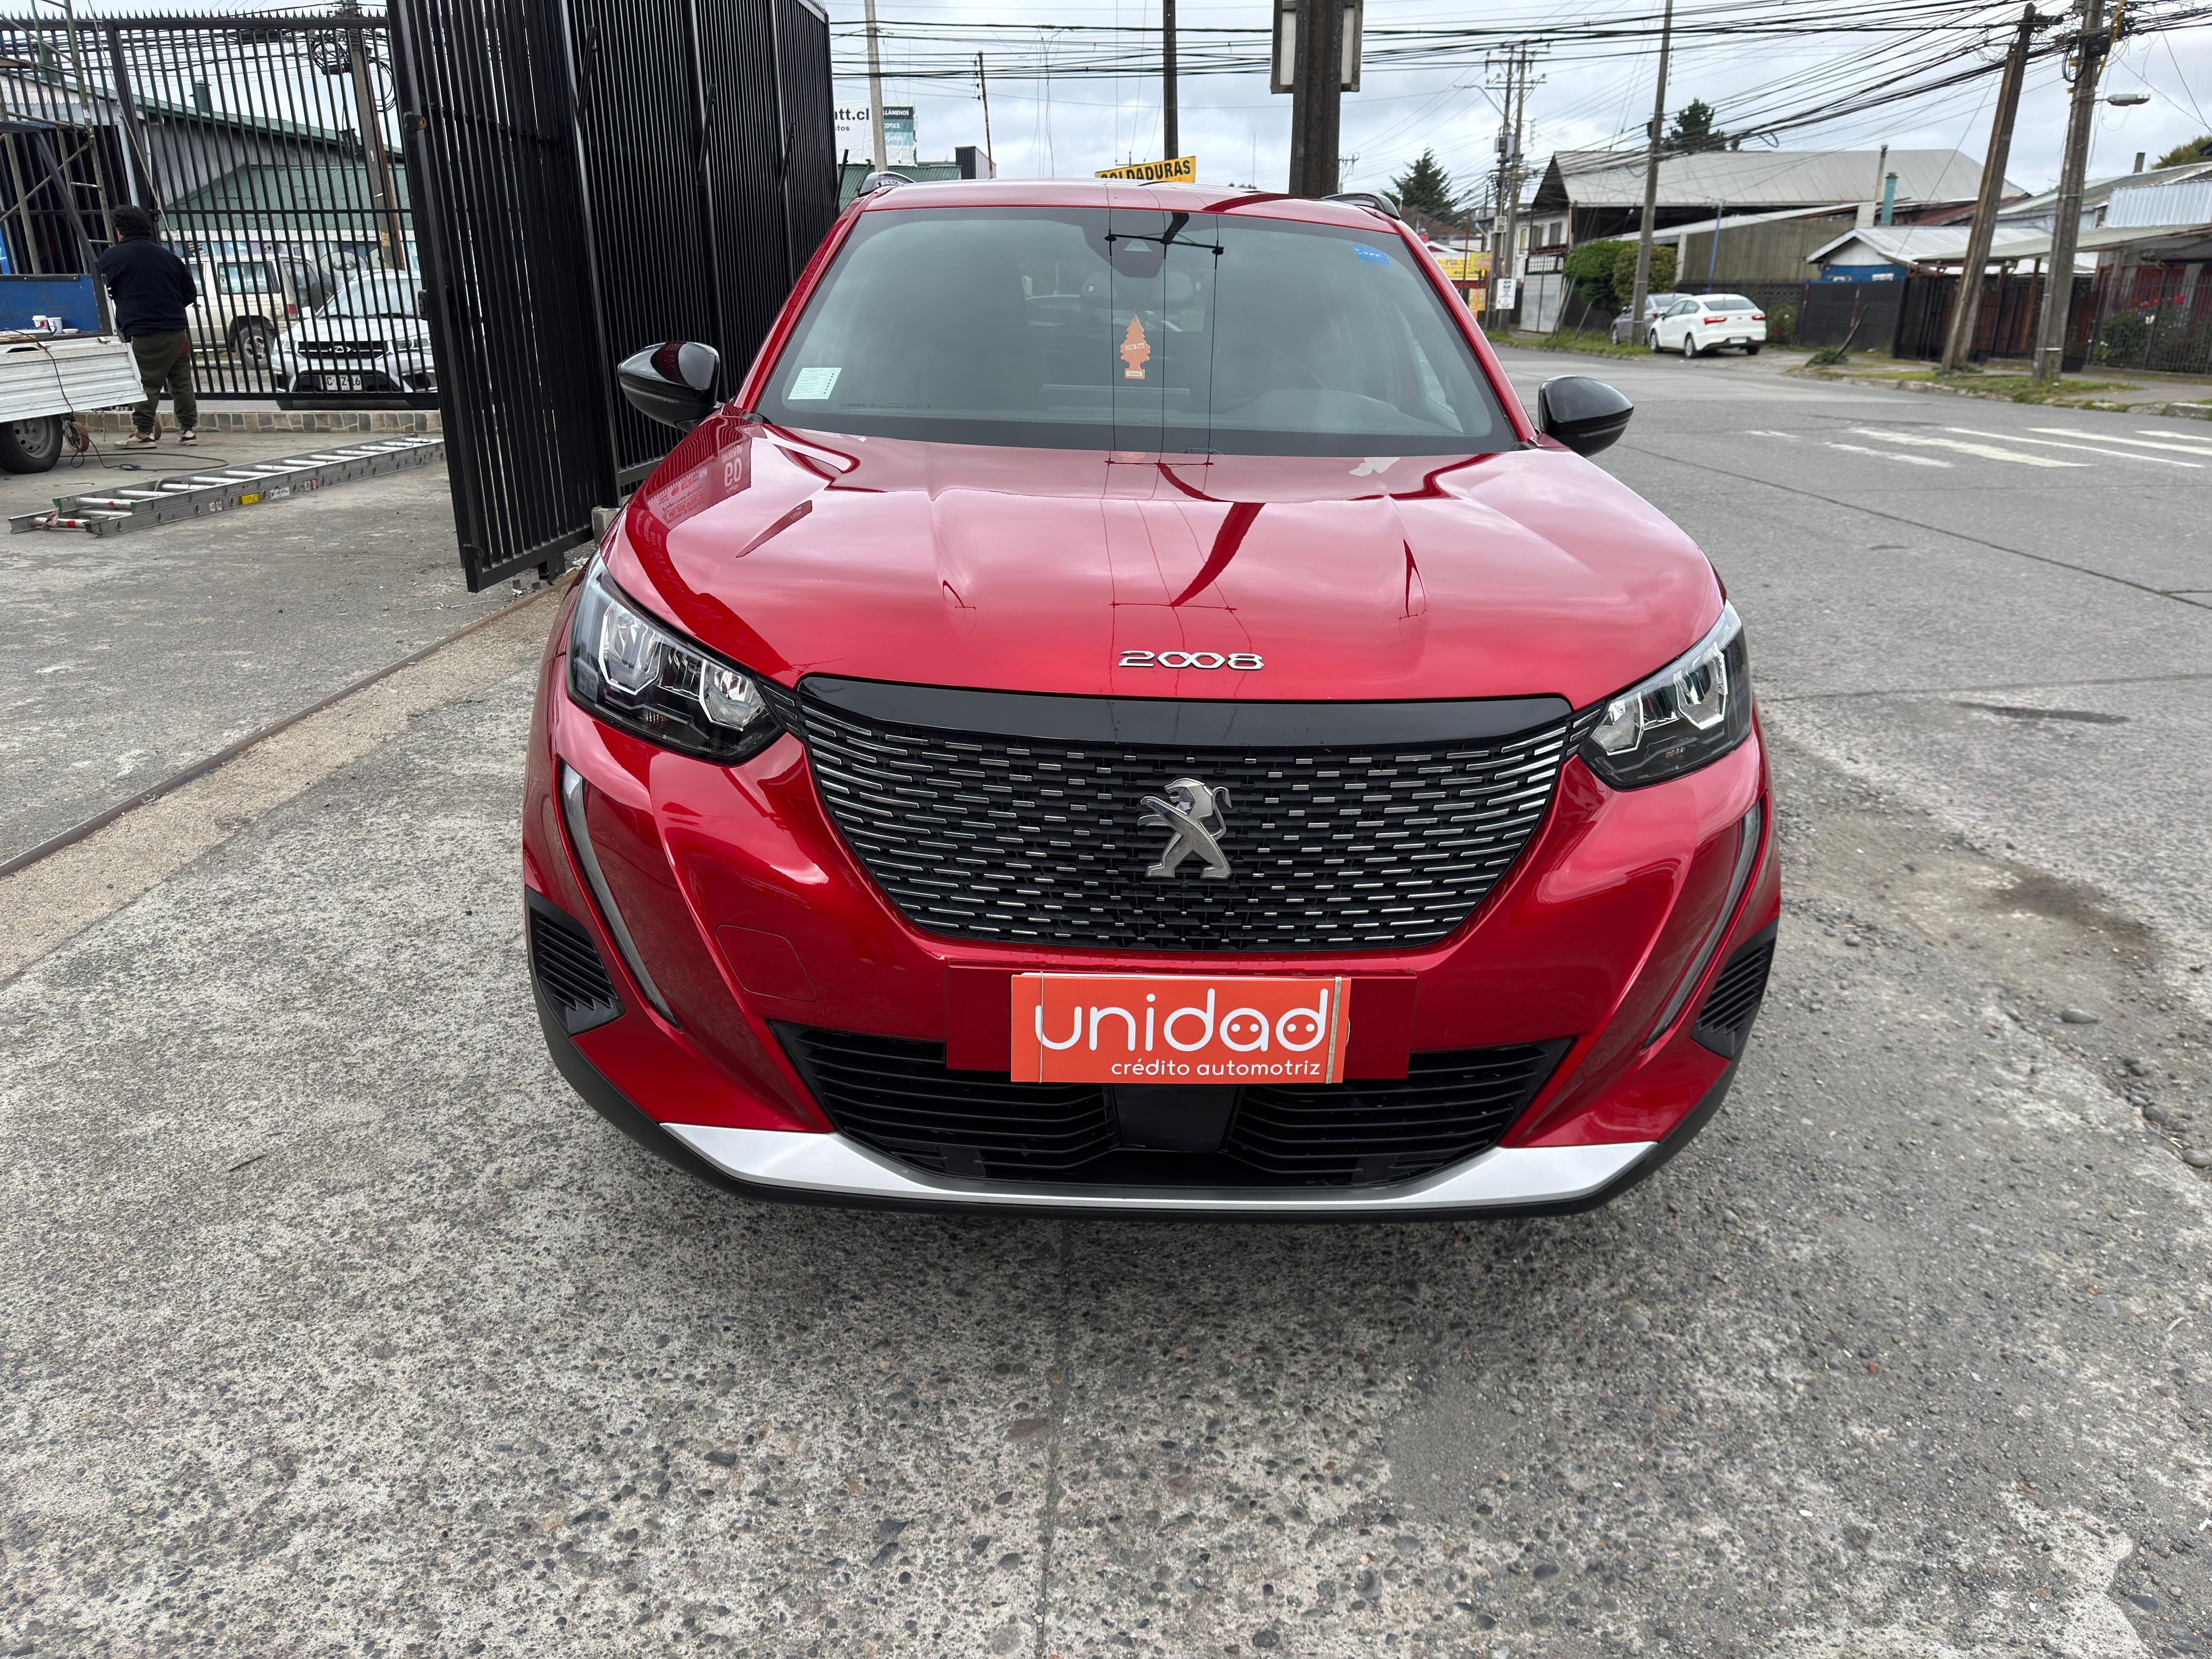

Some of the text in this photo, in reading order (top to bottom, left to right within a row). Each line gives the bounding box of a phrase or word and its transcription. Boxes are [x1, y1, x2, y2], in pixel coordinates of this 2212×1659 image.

[1101, 160, 1191, 180] LDADURAS
[1118, 650, 1264, 671] 2008
[1035, 988, 1329, 1052] unidad
[1111, 1058, 1321, 1076] crédito automotriz
